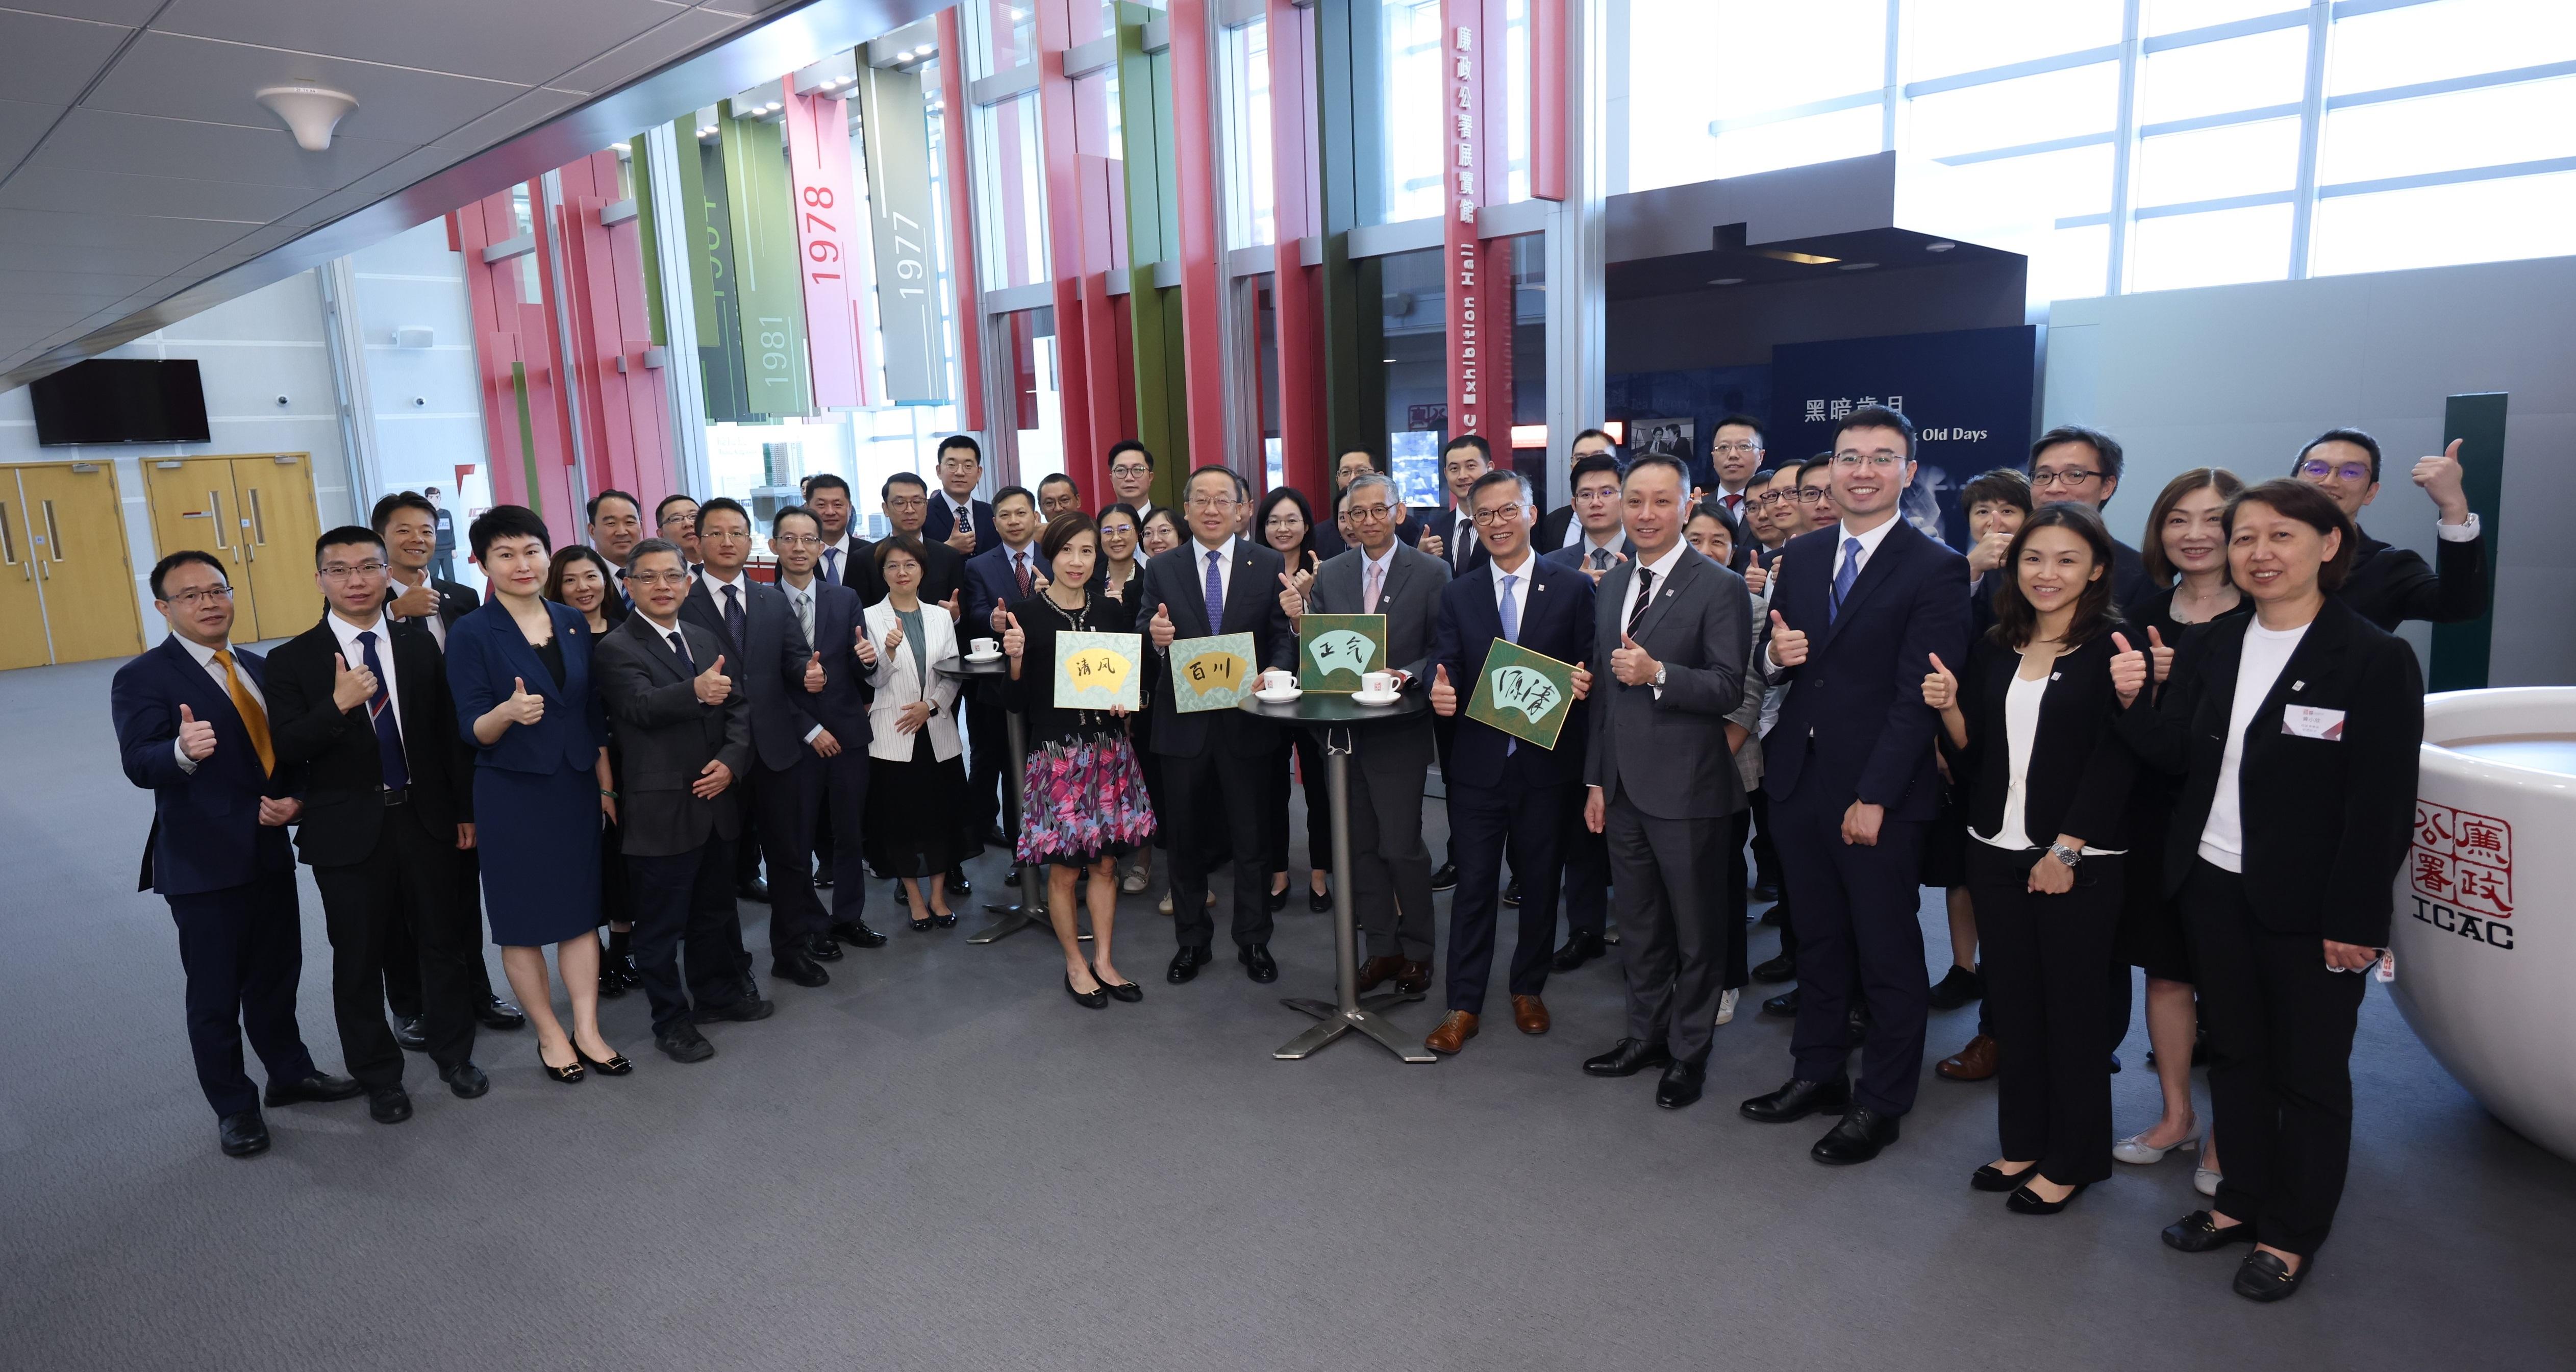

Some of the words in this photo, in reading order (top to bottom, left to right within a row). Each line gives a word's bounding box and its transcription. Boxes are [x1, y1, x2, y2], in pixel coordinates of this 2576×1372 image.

[1456, 26, 1474, 223] 廉政公署展覽館
[804, 186, 840, 284] 1978
[893, 211, 924, 298] 1977
[1461, 243, 1474, 285] Hall
[759, 317, 789, 387] 1981
[1462, 297, 1476, 405] Exhibition
[1922, 428, 1948, 441] Old
[1953, 427, 1988, 443] Days
[1076, 657, 1115, 677] 清风
[1189, 657, 1230, 681] 百川
[1319, 636, 1362, 663] 正气
[2411, 894, 2514, 950] ICAC
